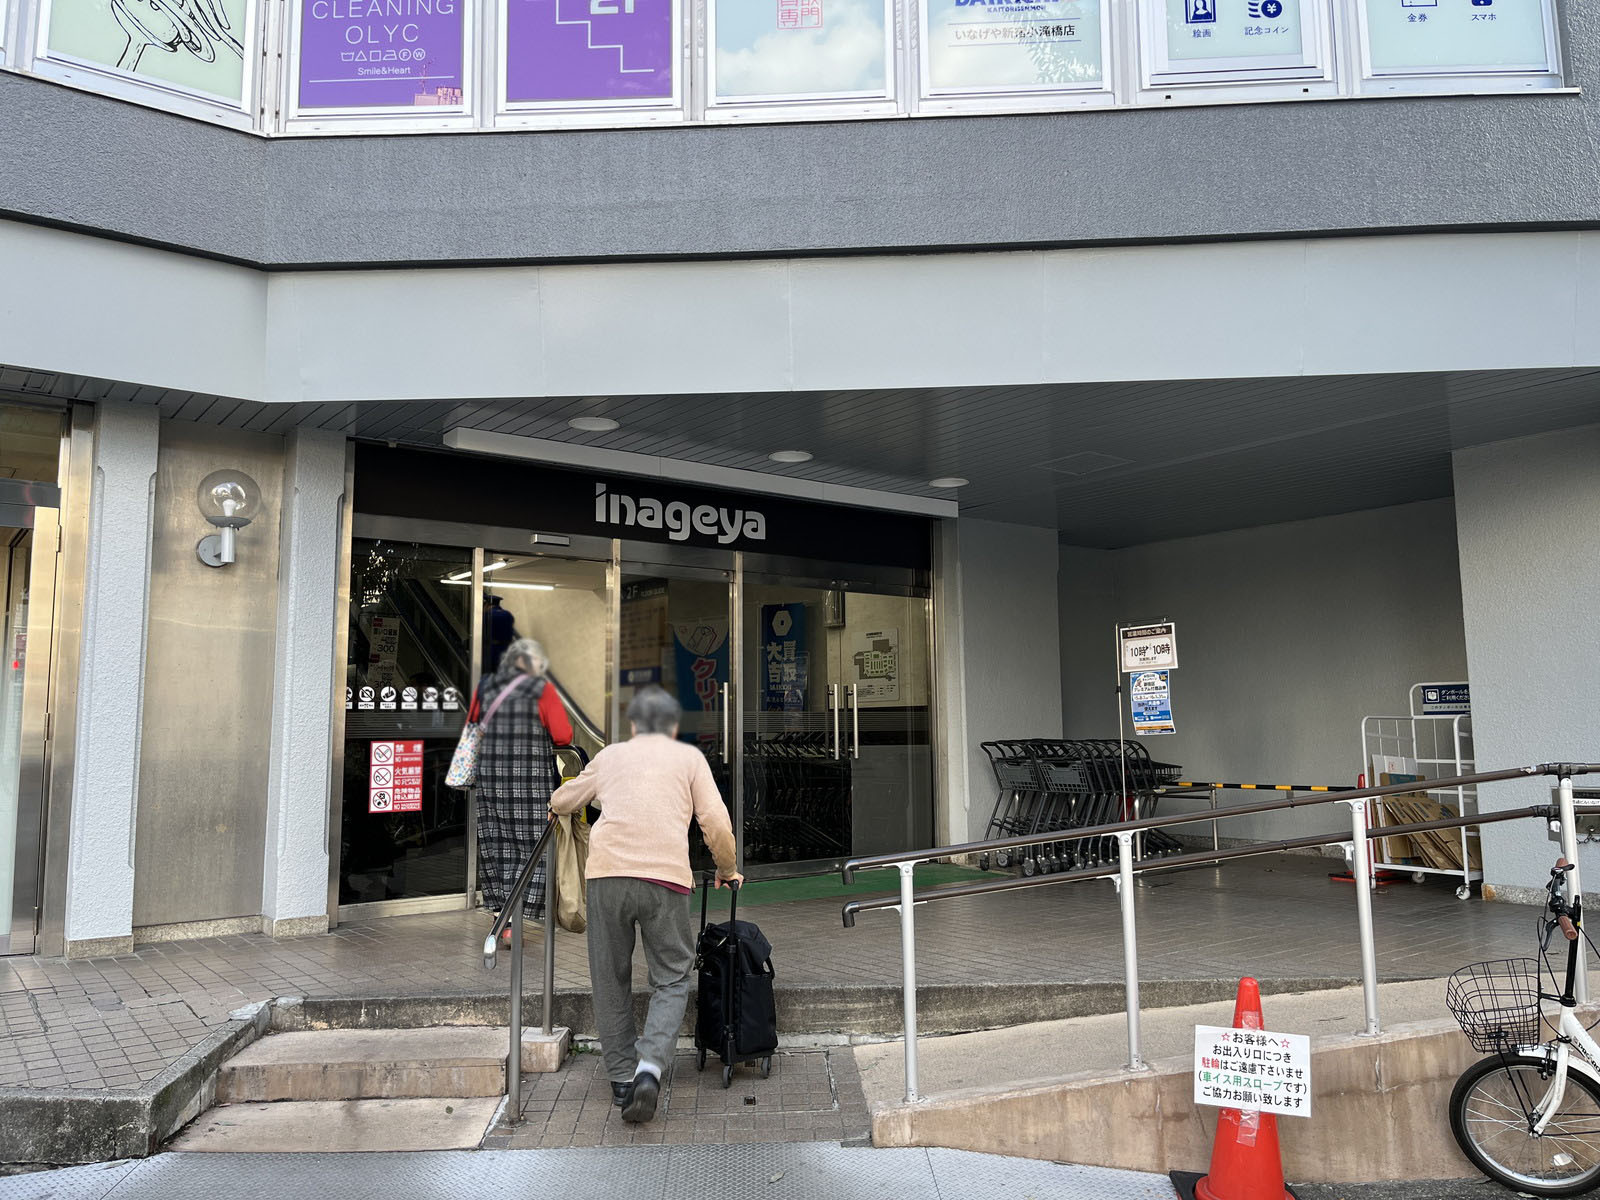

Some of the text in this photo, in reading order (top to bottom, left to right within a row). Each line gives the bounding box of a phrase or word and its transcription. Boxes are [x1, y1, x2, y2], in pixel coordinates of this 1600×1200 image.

[312, 0, 454, 19] CLEANING
[1407, 13, 1428, 23] 金券
[1471, 13, 1497, 21] スマホ
[345, 23, 419, 45] OLYC
[1192, 28, 1212, 38] 絵画
[1244, 25, 1289, 36] 記念コイン
[357, 66, 412, 76] Smile&Heart
[595, 482, 766, 544] inageya
[1212, 1044, 1292, 1064] お出入り口につき
[1201, 1057, 1304, 1079] 駐輪はご遠慮下さいませ
[1202, 1086, 1303, 1108] ご協力お願い致します
